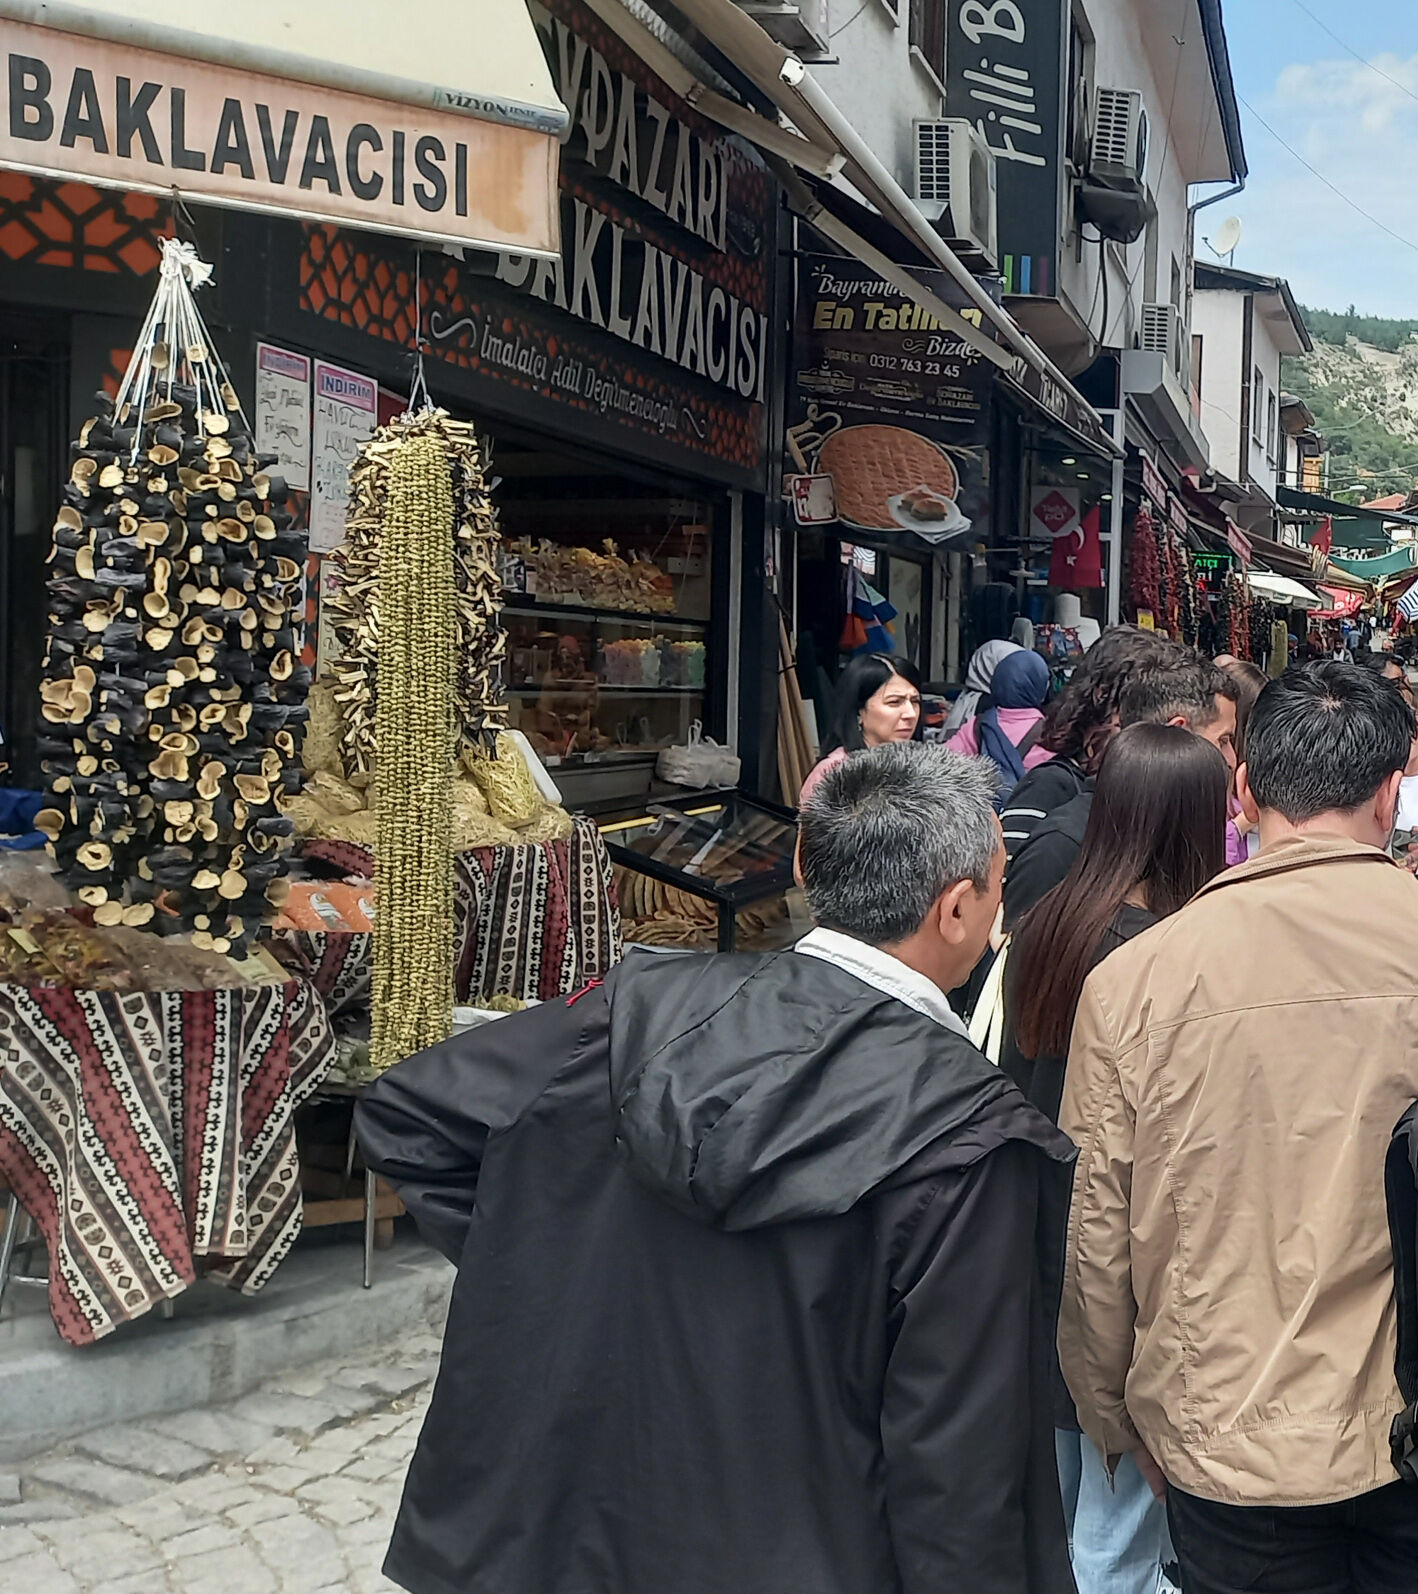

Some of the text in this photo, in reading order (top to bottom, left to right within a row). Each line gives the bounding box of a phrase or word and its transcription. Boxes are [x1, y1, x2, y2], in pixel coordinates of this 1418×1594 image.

[8, 53, 468, 217] BAKLAVACISI
[531, 0, 728, 254] YPAZARI
[962, 57, 1047, 167] Filli
[812, 301, 854, 329] En
[869, 353, 897, 370] 0312
[900, 358, 922, 373] 763
[925, 361, 940, 375] 23
[943, 364, 961, 378] 45
